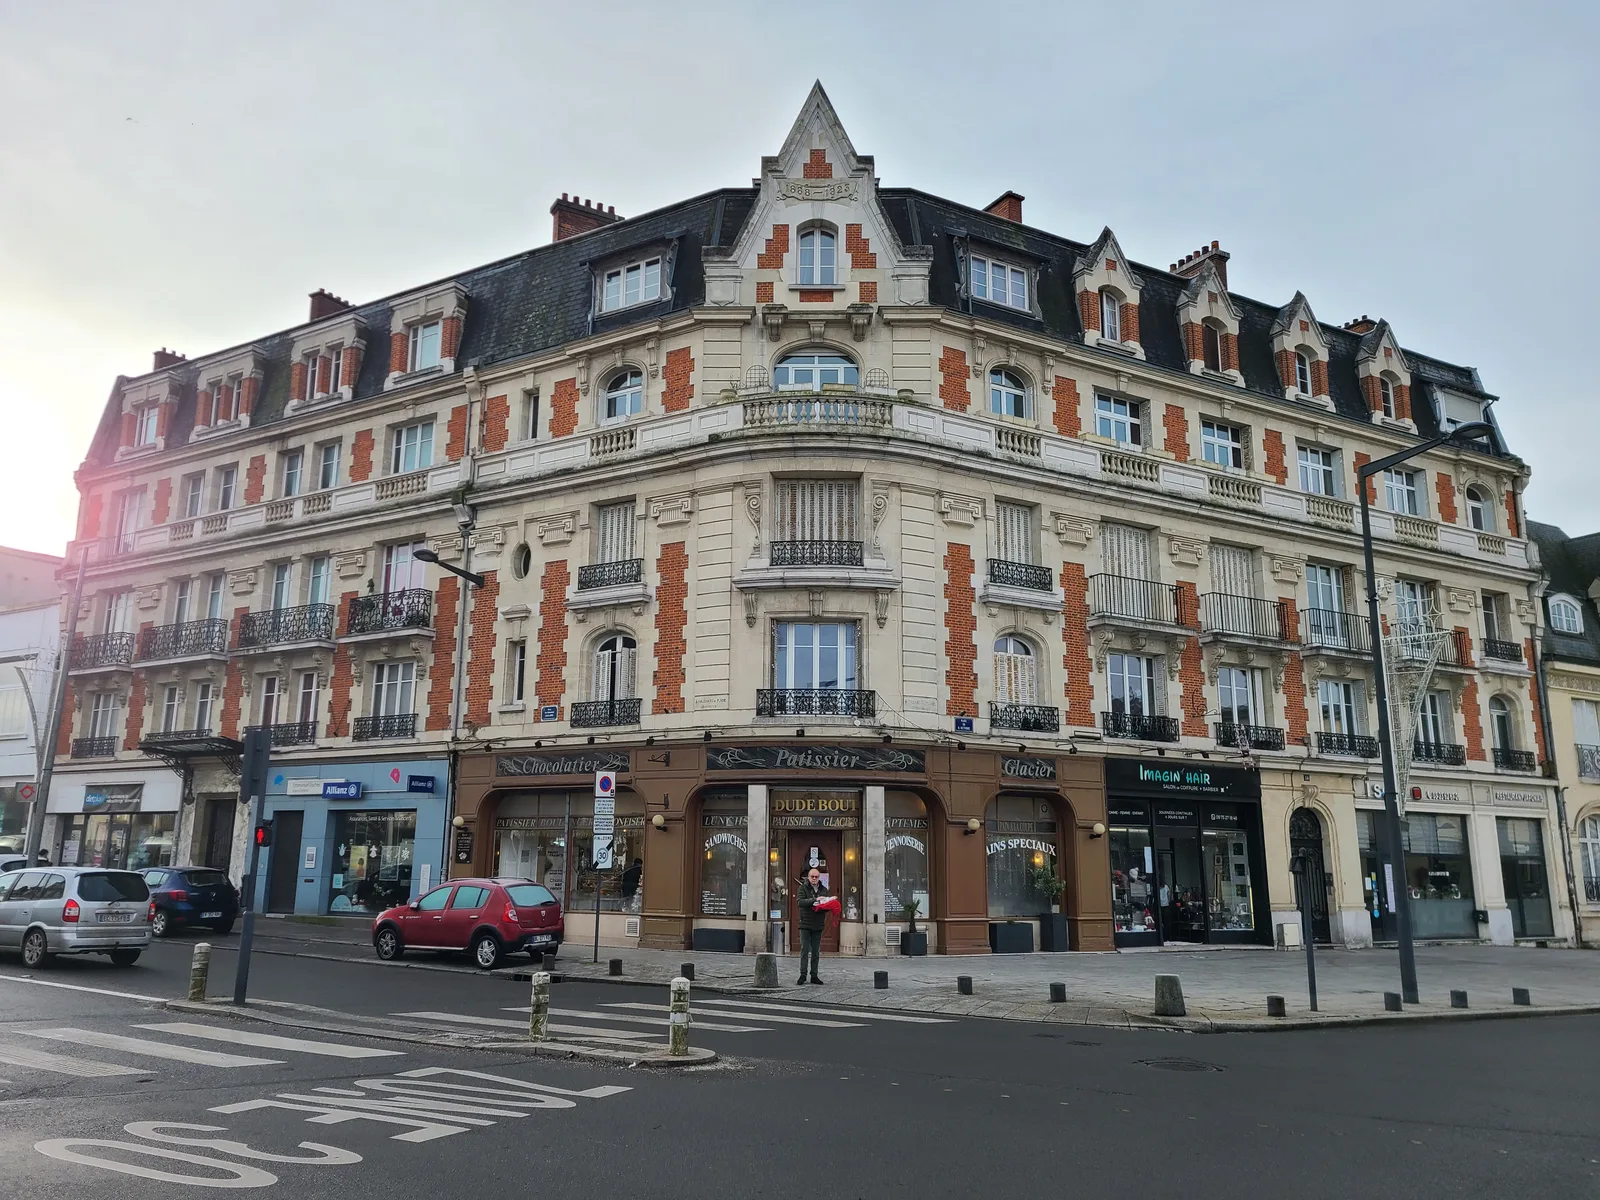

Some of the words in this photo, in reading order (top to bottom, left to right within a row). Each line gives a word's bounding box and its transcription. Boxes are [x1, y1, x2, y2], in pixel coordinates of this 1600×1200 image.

[522, 756, 600, 774] Chocolatier
[774, 749, 861, 769] Patissier
[1004, 759, 1054, 778] Glacier
[326, 785, 348, 795] Allianz
[496, 818, 536, 827] PATISSIER
[540, 817, 592, 827] BOULNGER
[772, 816, 812, 827] PATISSIER
[823, 816, 858, 828] GLACIER
[885, 818, 928, 829] APTEMES
[704, 833, 747, 854] SANDWICHES
[986, 841, 1007, 856] AINS
[1008, 839, 1056, 857] SPECIAUX
[598, 851, 606, 860] 30
[208, 1066, 633, 1143] ZONE
[34, 1120, 363, 1189] 30
